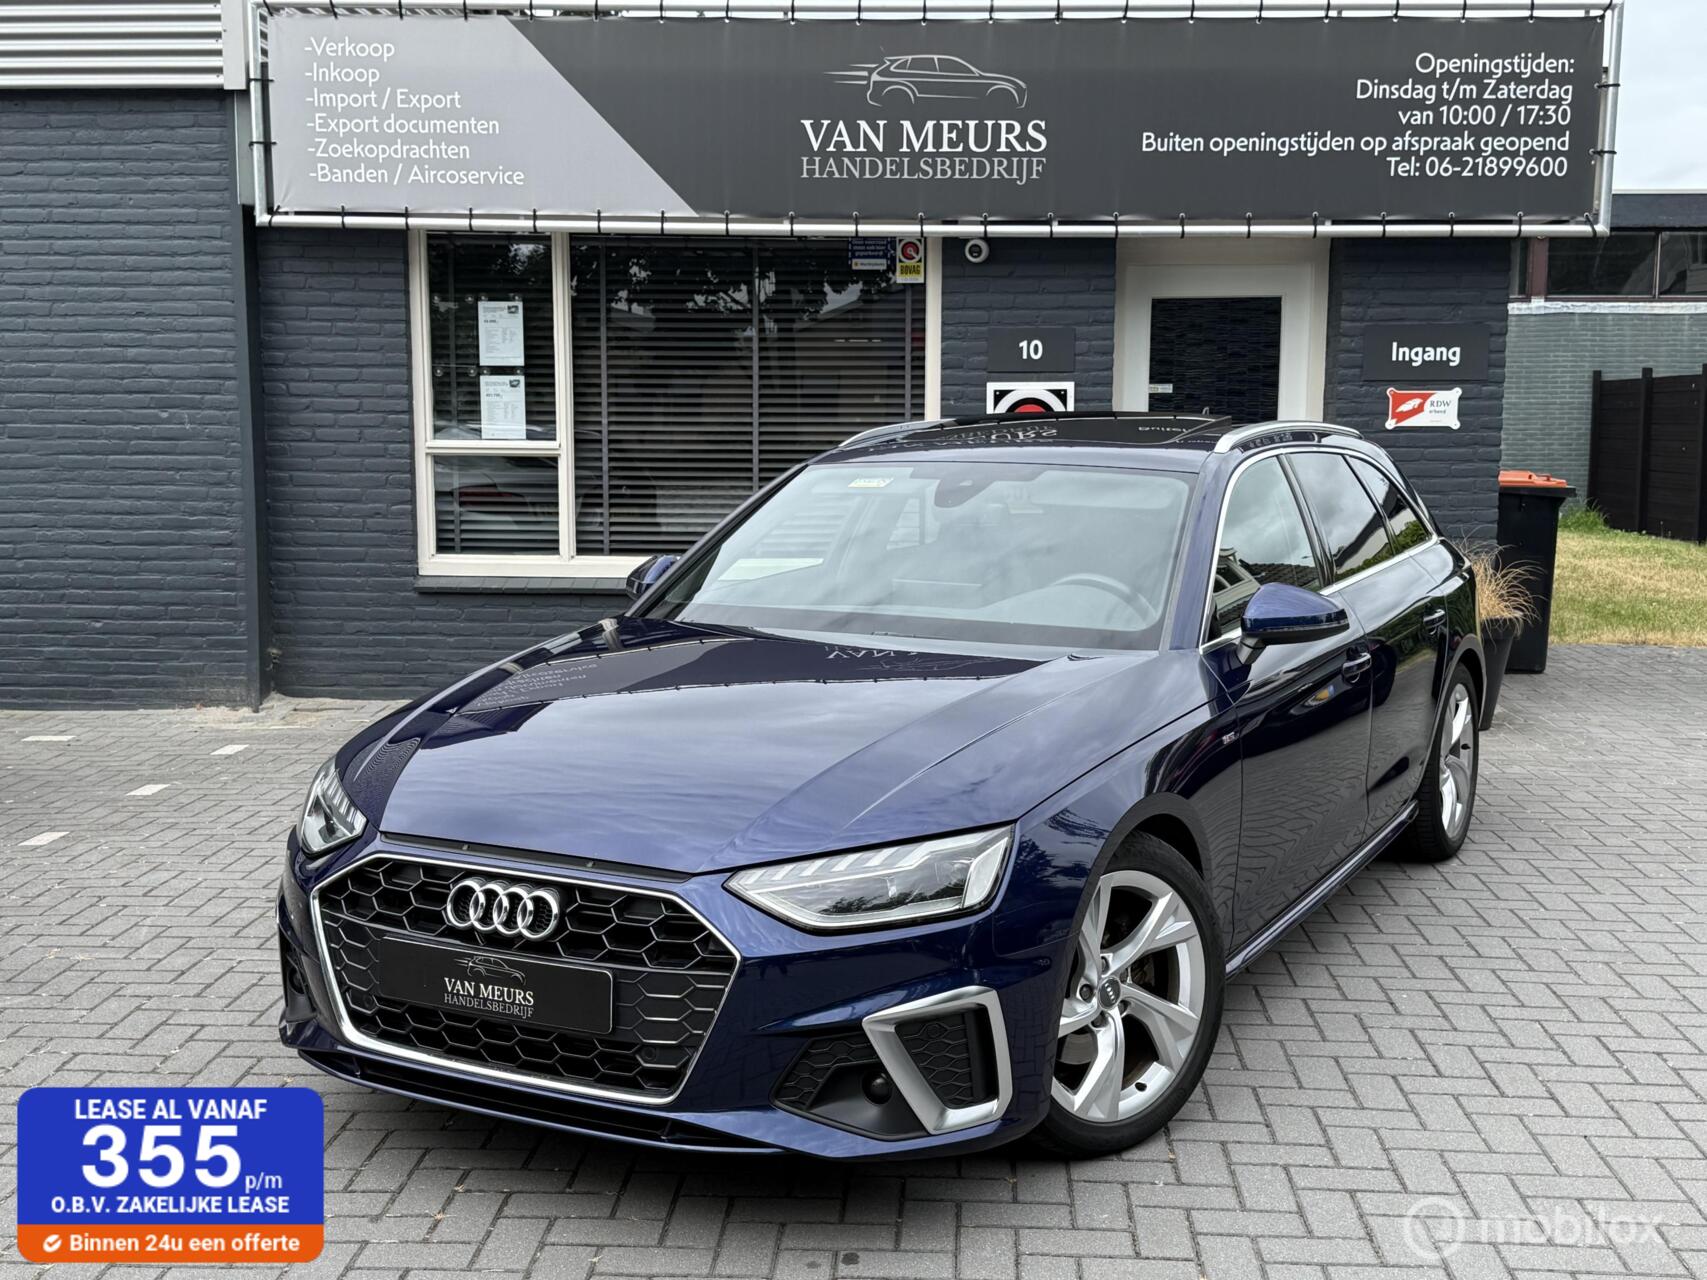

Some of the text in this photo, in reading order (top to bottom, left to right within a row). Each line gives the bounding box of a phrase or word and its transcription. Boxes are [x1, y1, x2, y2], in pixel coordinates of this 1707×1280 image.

[304, 37, 395, 61] -Verkoop
[304, 62, 380, 85] -Inkoop
[1415, 52, 1575, 76] Openingstijden:
[305, 88, 378, 112] -Import
[396, 89, 461, 112] Export
[1356, 79, 1573, 103] Dinsdag t/m Zaterdag
[306, 113, 500, 137] -Export documenten
[1398, 109, 1434, 126] van
[1440, 105, 1495, 126] 10:00
[1517, 105, 1571, 126] 17:30
[800, 119, 1048, 153] VAN MEURS
[1142, 131, 1569, 156] Buiten openingstijden op afspraak geopend
[307, 139, 470, 163] -Zoekopdrachten
[309, 163, 389, 185] -Banden
[408, 164, 525, 186] Aircoservice
[800, 156, 1047, 186] HANDELSBEDRIJF
[1387, 157, 1568, 177] Tel: 06-21899600
[900, 264, 921, 275] BOVAG
[1018, 339, 1043, 359] 10
[1391, 341, 1461, 367] Ingang
[1429, 400, 1452, 408] RDW
[444, 977, 535, 1006] VAN MEURS
[444, 993, 534, 1019] HANDELSBEDRIJF
